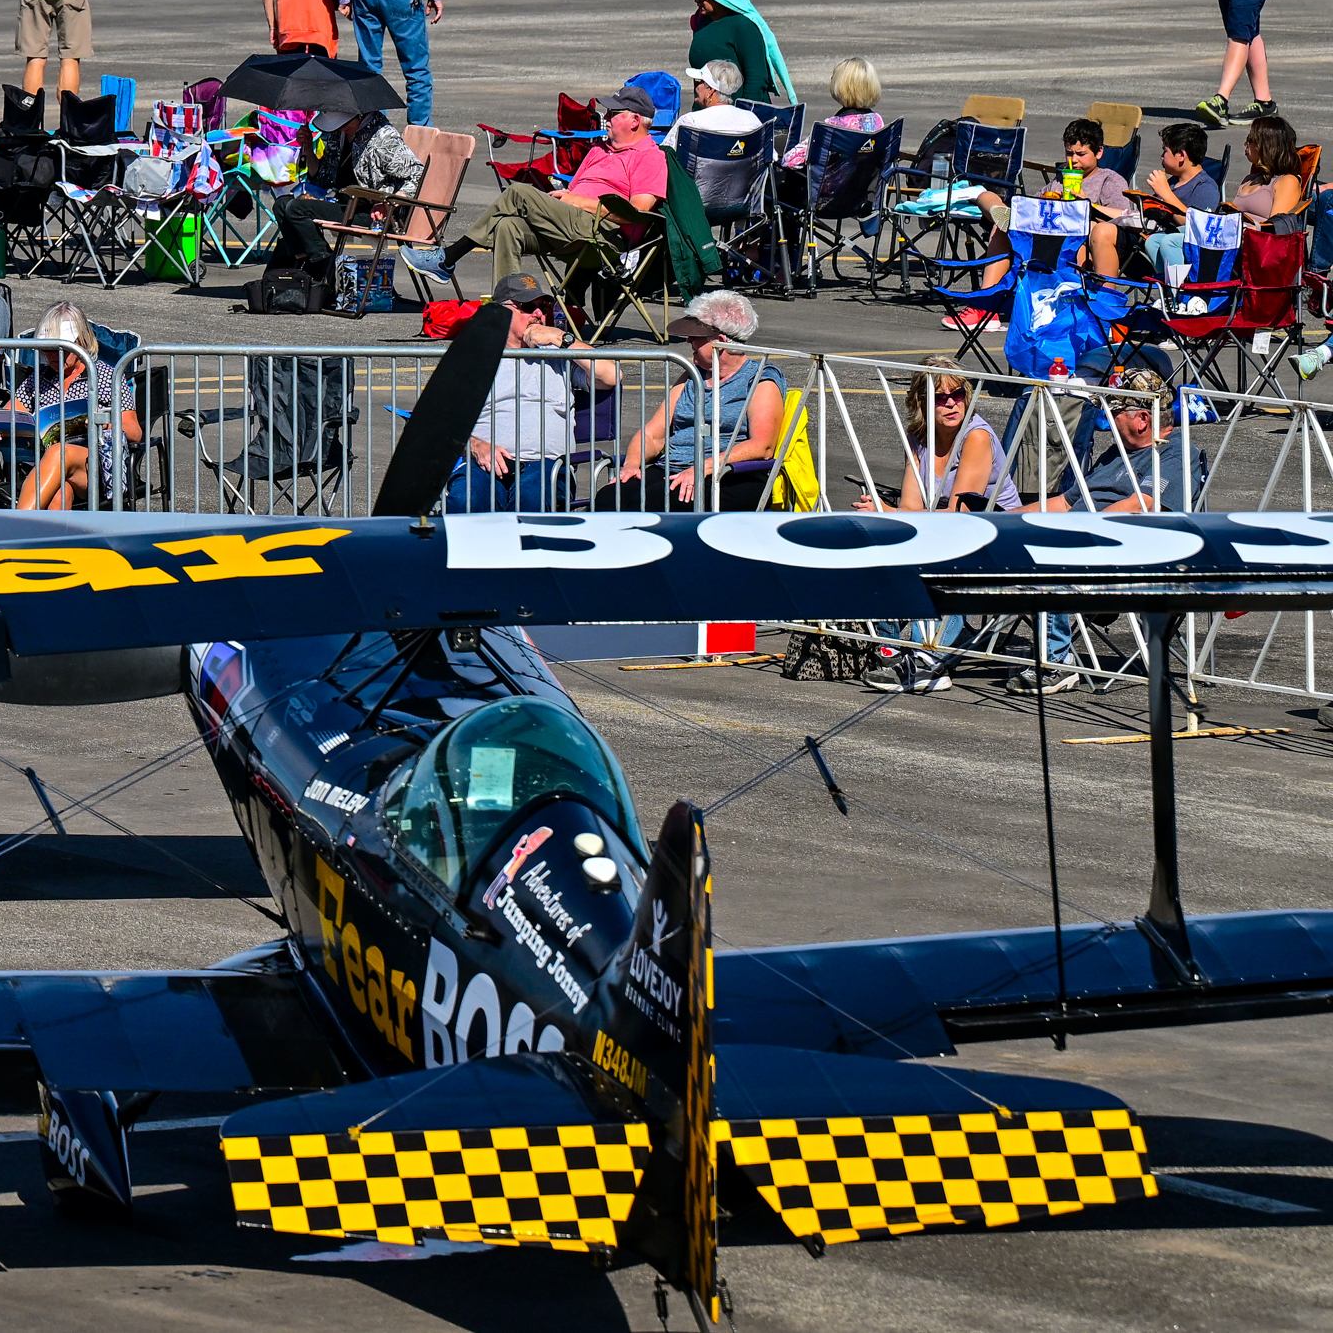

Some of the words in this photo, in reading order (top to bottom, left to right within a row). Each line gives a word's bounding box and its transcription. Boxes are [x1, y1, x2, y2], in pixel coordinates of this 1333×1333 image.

[1038, 199, 1063, 230] UK
[1205, 216, 1223, 246] UK
[305, 778, 325, 803] JON
[325, 783, 370, 814] MELBY
[520, 860, 573, 933] Adventures
[566, 922, 593, 948] of
[316, 853, 417, 1064] Fear
[495, 886, 553, 967] Jumping
[547, 951, 590, 1015] Jonny
[629, 941, 683, 1017] LOVEJOY
[656, 1012, 682, 1043] CLINIC
[48, 1109, 90, 1186] BOSS
